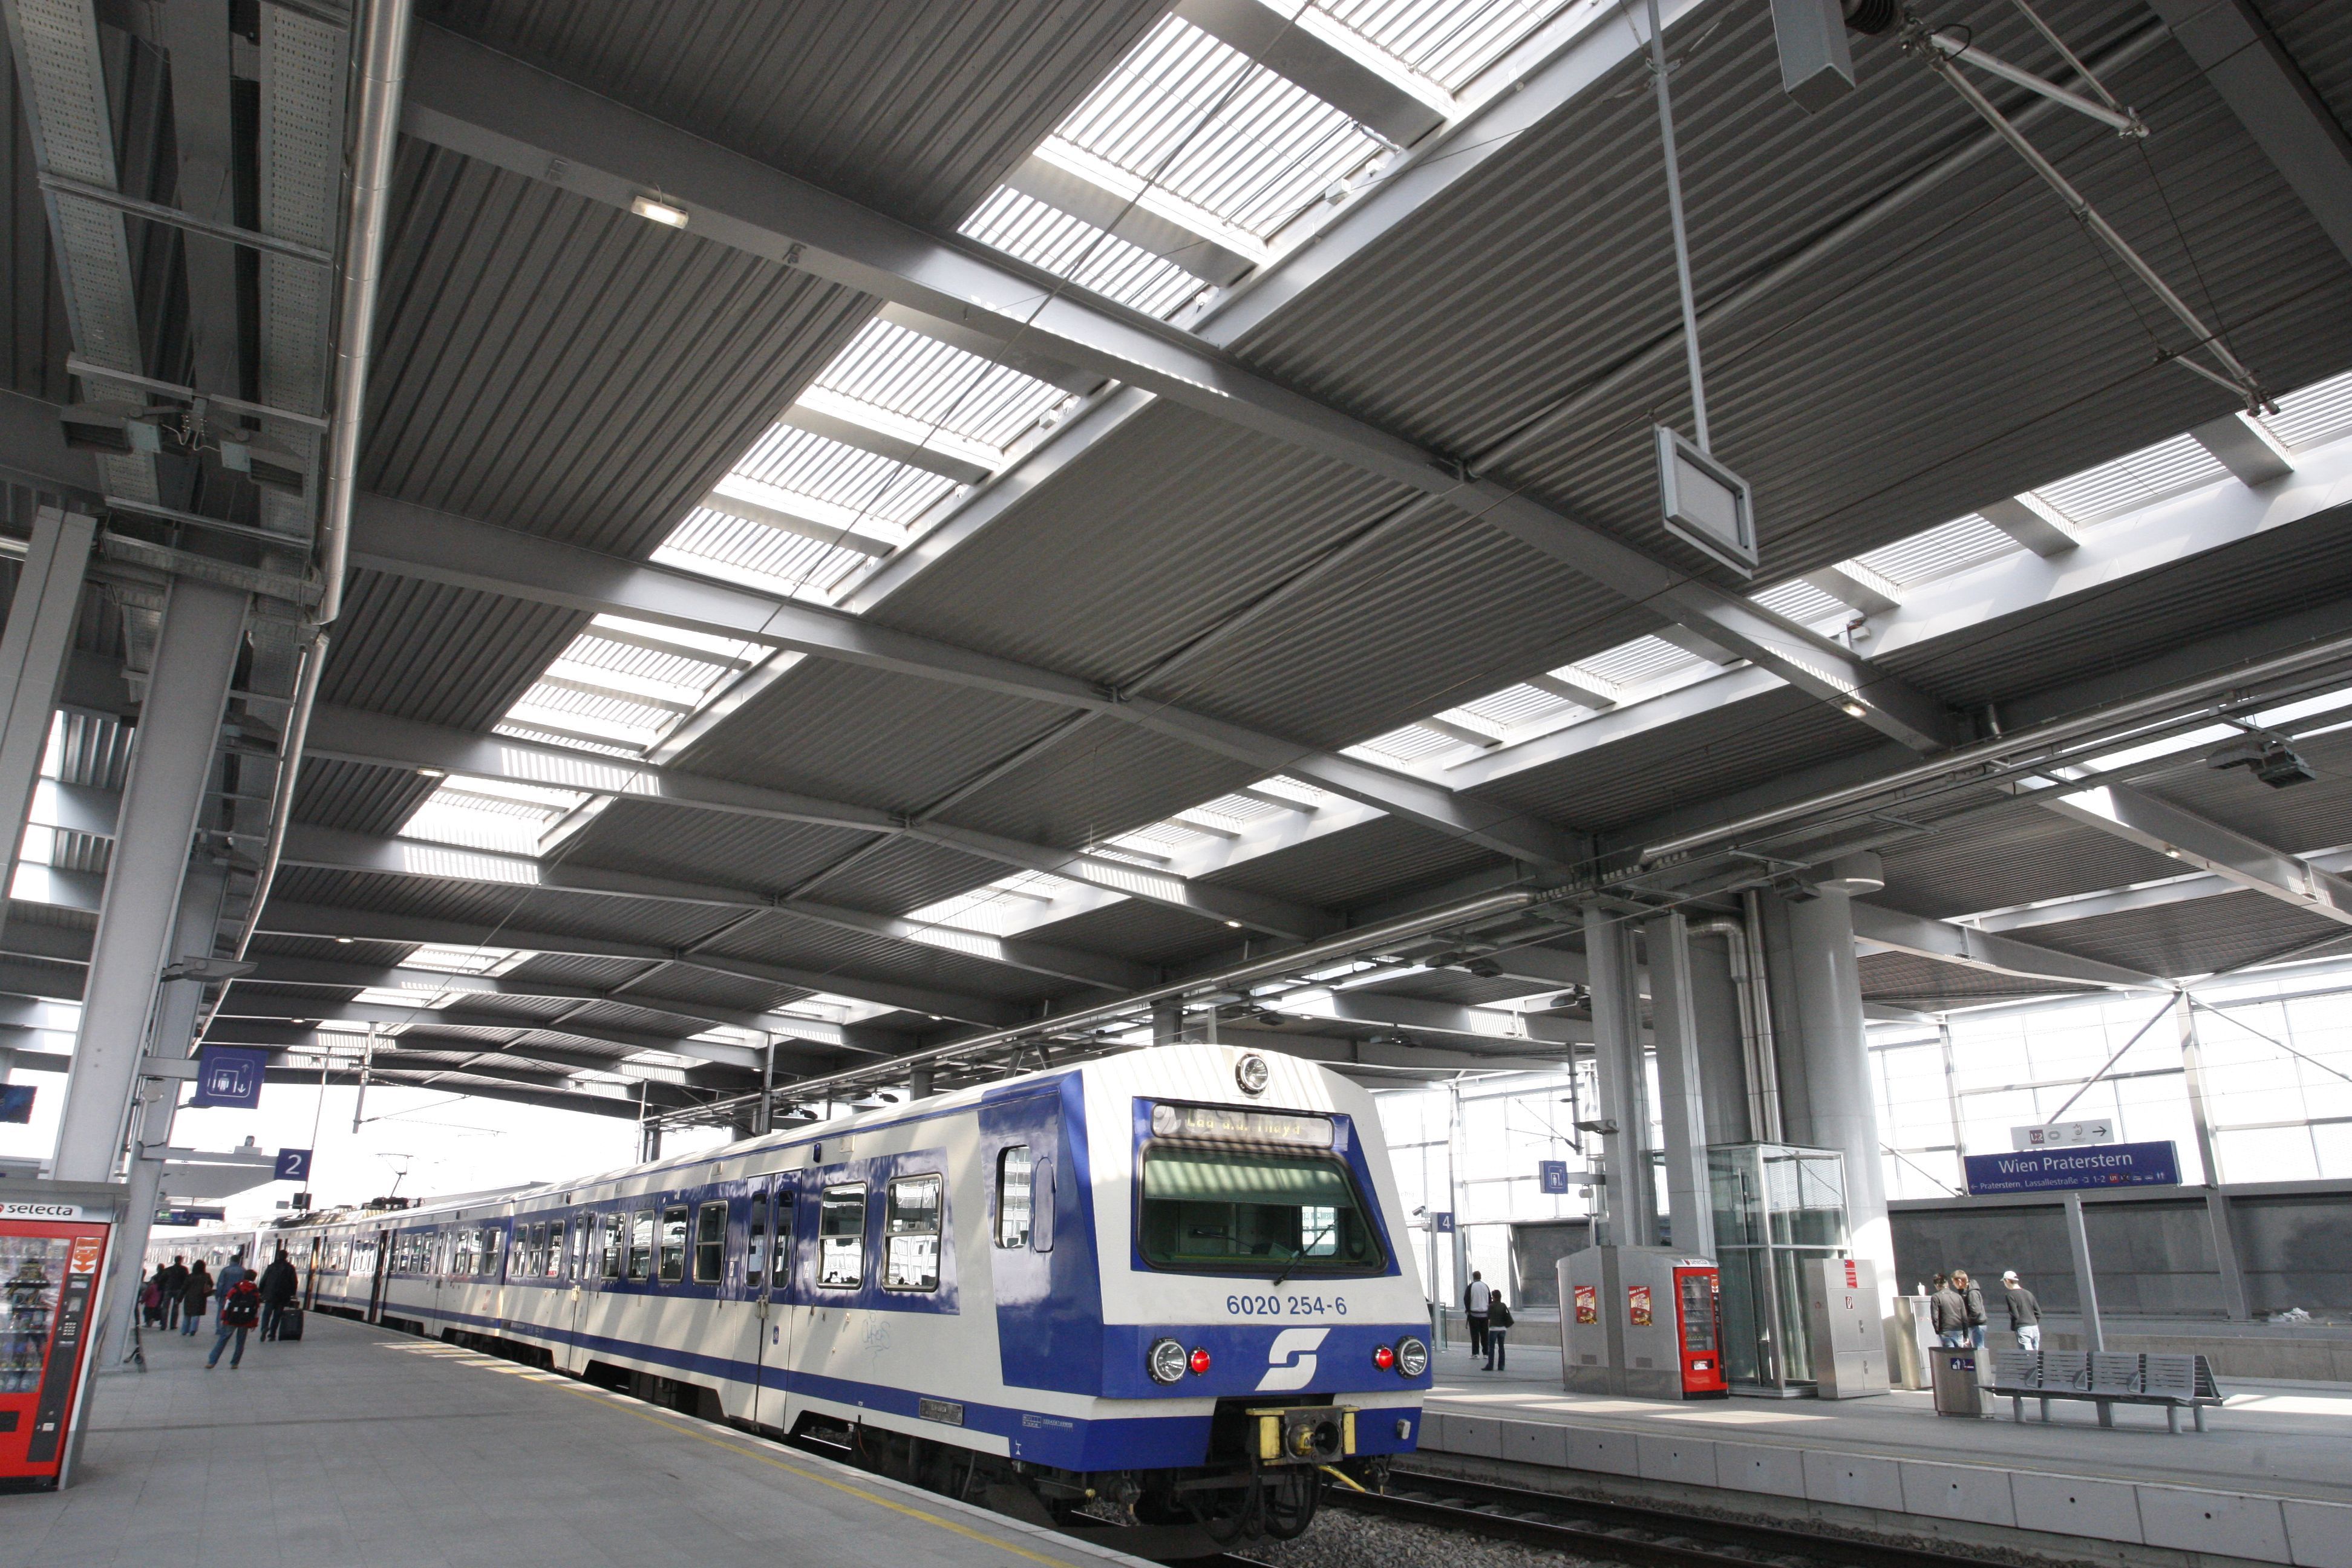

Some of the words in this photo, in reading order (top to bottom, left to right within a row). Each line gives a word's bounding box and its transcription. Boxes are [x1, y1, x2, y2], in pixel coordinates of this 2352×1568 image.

[285, 1154, 302, 1175] 2
[1998, 1159, 2038, 1174] Wien
[2043, 1154, 2132, 1171] Praterstern
[2025, 1177, 2078, 1187] Lassallestraße
[7, 1204, 73, 1216] selecta
[1442, 1215, 1451, 1229] 4
[1226, 1295, 1281, 1315] 6020
[1287, 1296, 1347, 1315] 254-6
